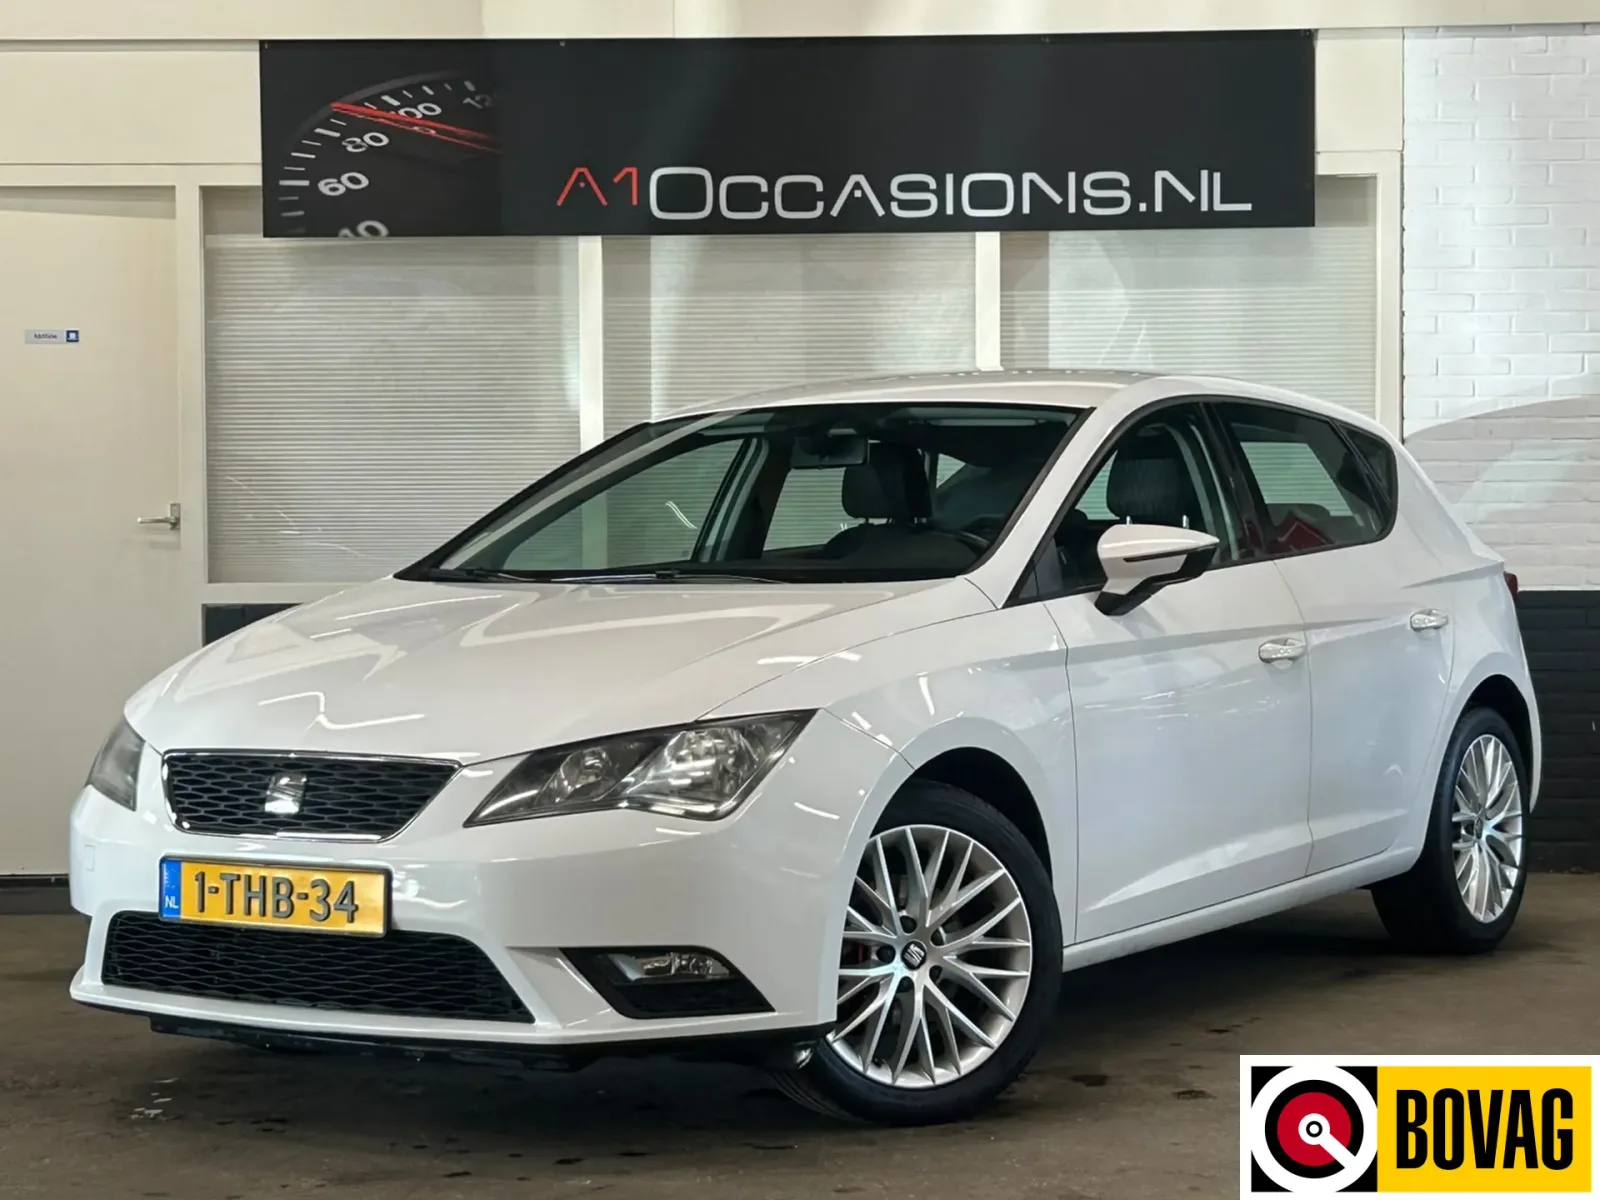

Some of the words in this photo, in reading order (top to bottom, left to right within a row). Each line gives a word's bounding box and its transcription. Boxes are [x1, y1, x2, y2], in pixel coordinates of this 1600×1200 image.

[341, 131, 390, 153] 80
[317, 171, 370, 197] 60
[164, 895, 180, 910] NL
[194, 871, 360, 925] 1-THB-34
